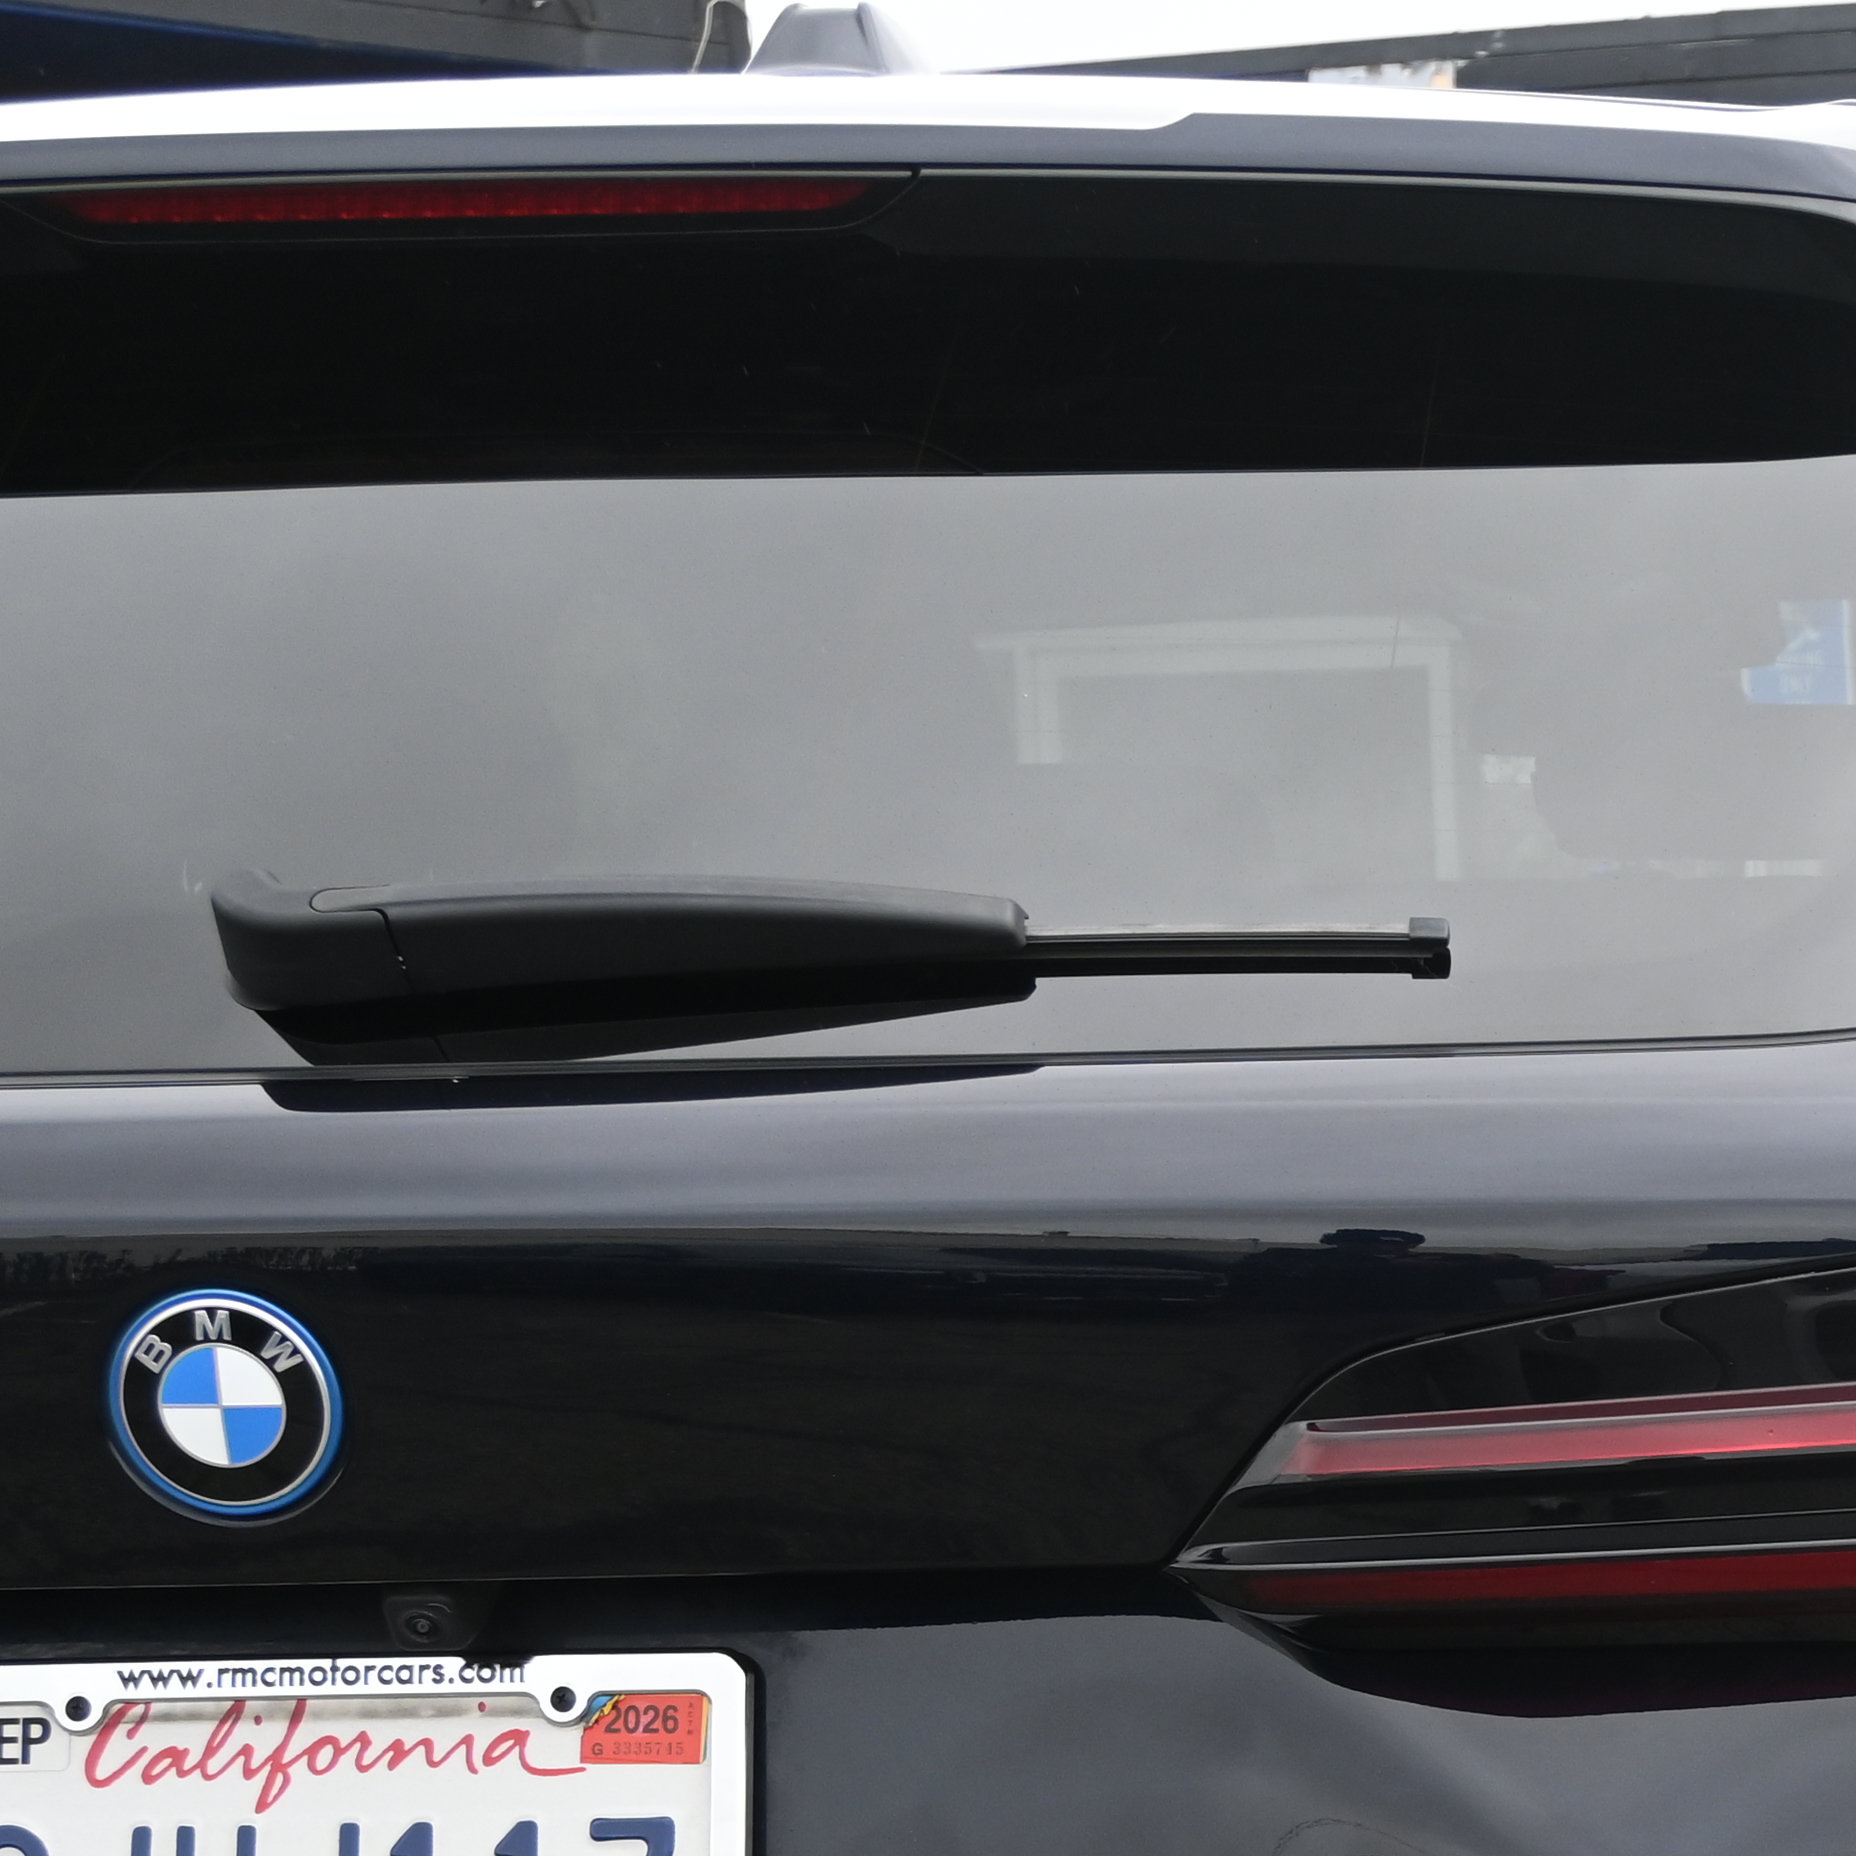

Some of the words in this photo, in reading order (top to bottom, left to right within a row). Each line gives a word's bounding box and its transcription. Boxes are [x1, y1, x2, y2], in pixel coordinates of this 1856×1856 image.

[133, 1309, 304, 1375] BMW
[116, 1658, 527, 1691] www.rmcmotorcars.com
[603, 1704, 679, 1735] 2026
[85, 1699, 587, 1814] California
[591, 1742, 604, 1756] G
